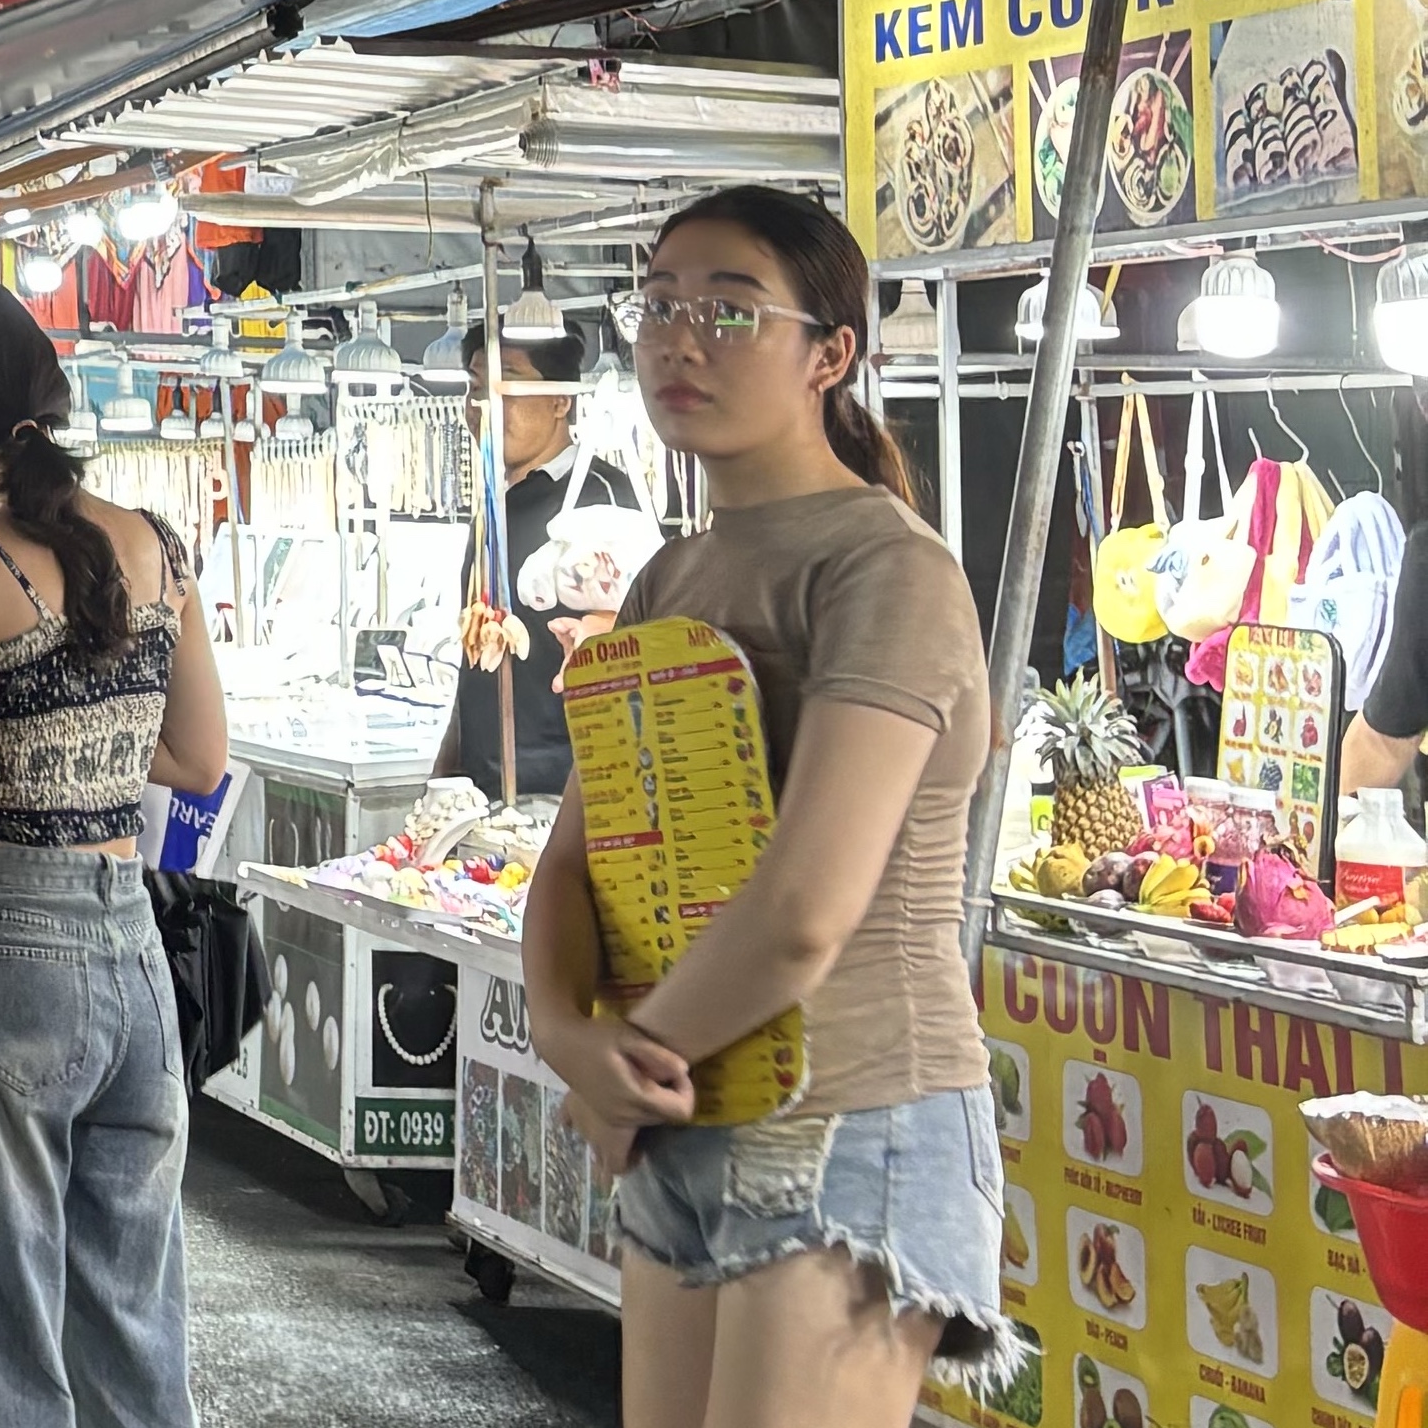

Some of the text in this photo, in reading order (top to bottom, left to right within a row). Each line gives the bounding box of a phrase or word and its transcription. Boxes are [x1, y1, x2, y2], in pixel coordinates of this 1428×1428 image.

[596, 633, 641, 663] Oanh
[364, 1110, 445, 1146] ĐT: 0939
